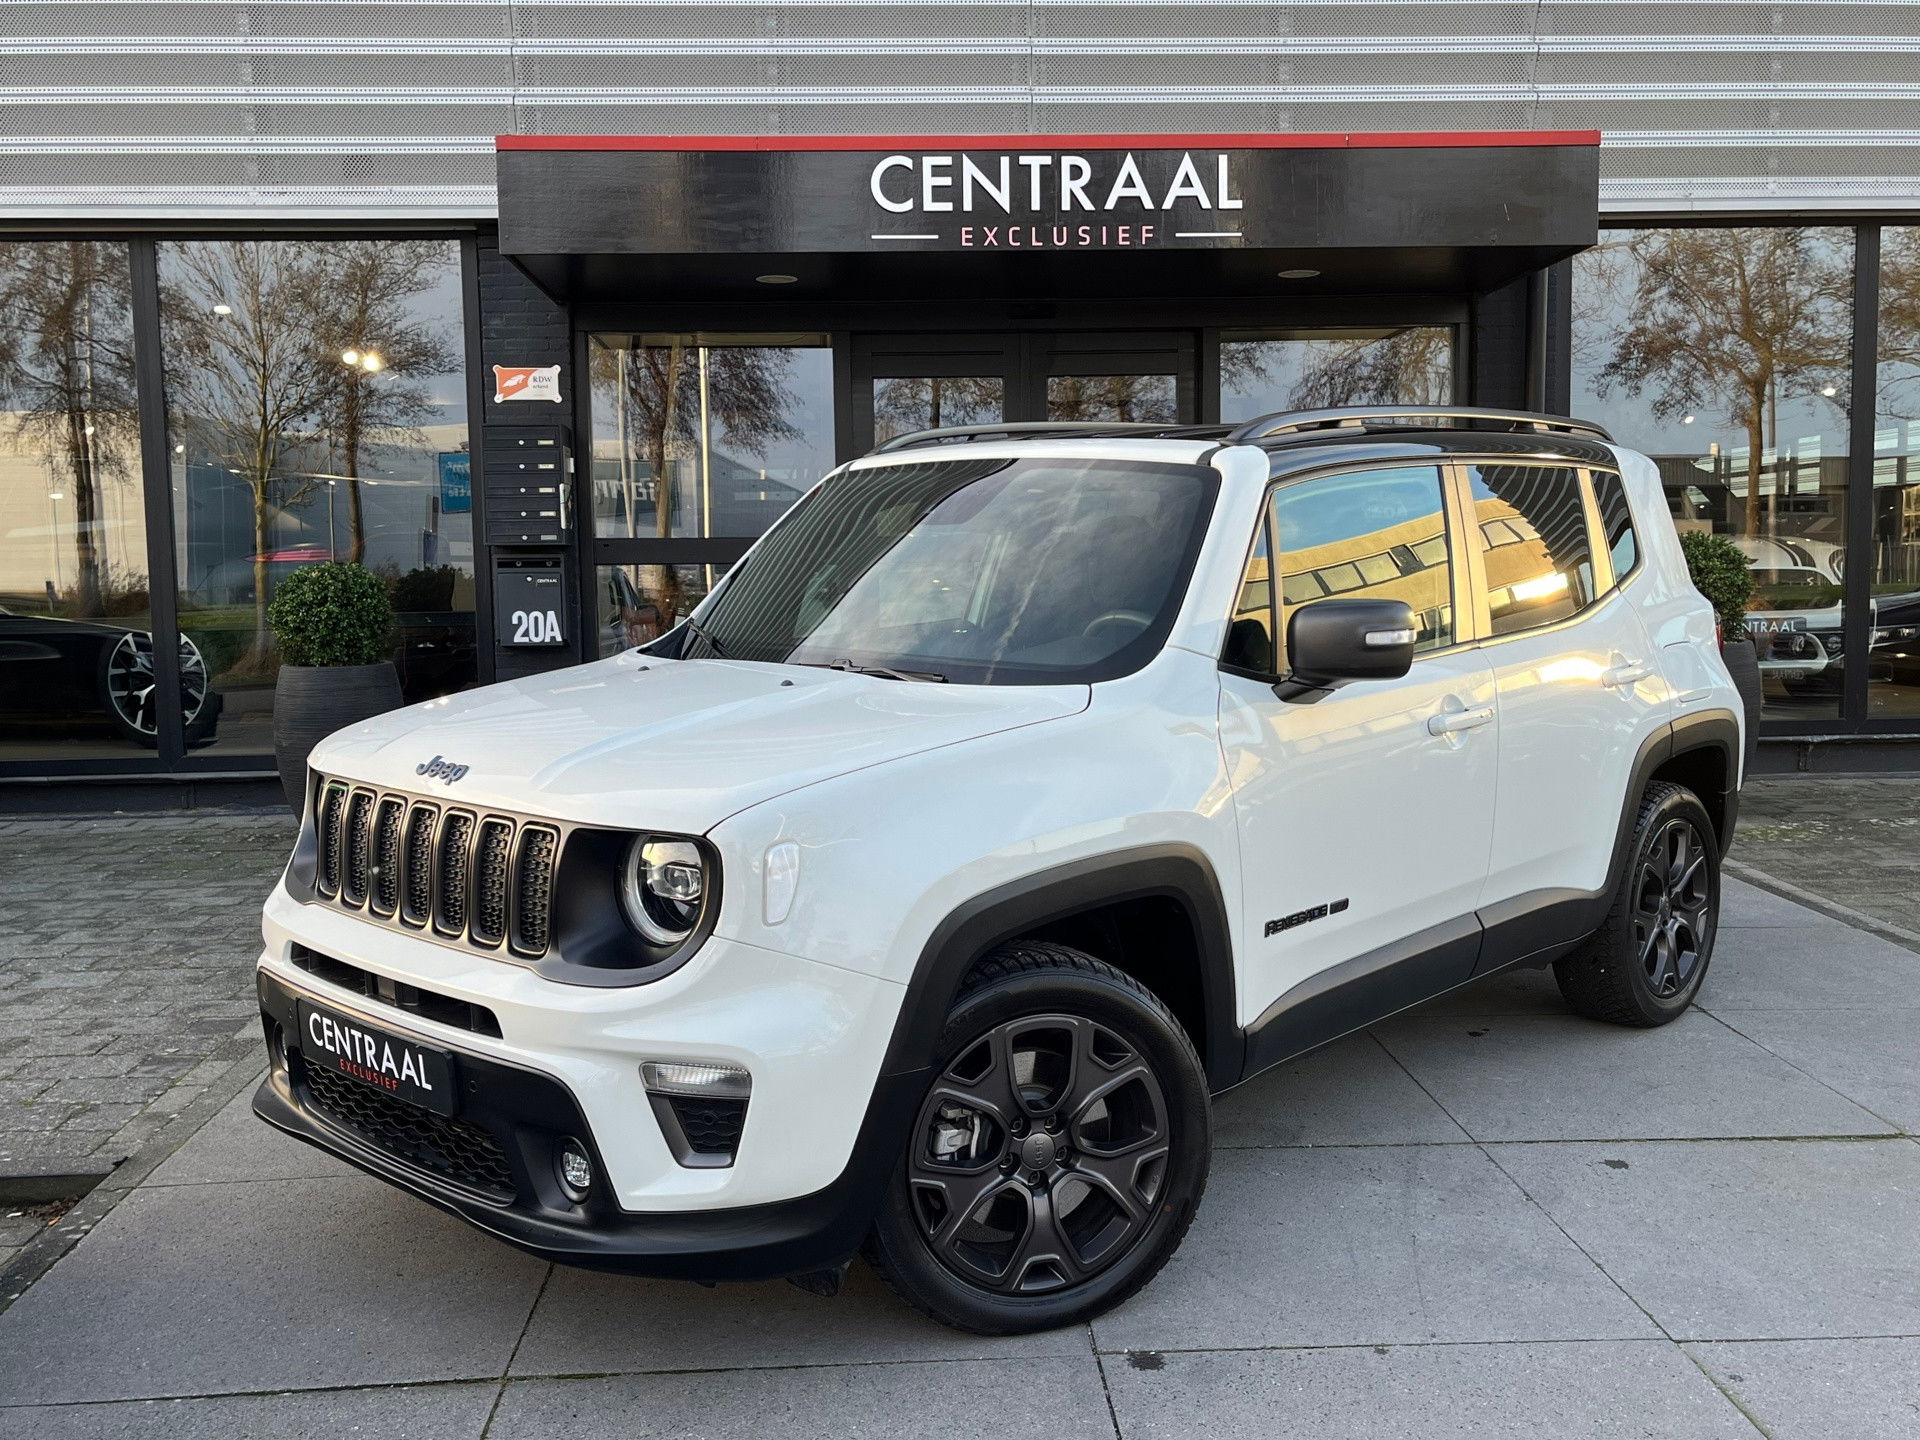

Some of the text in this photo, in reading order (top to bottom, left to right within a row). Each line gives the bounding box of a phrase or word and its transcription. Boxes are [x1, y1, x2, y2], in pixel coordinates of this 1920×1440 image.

[870, 152, 1243, 214] CENTRAAL
[961, 226, 1155, 246] EXCLUSIEF
[512, 610, 562, 643] 20A
[416, 755, 469, 786] Jeep
[309, 1012, 432, 1091] CENTRAAL
[339, 1059, 398, 1091] EXCLUSIEF
